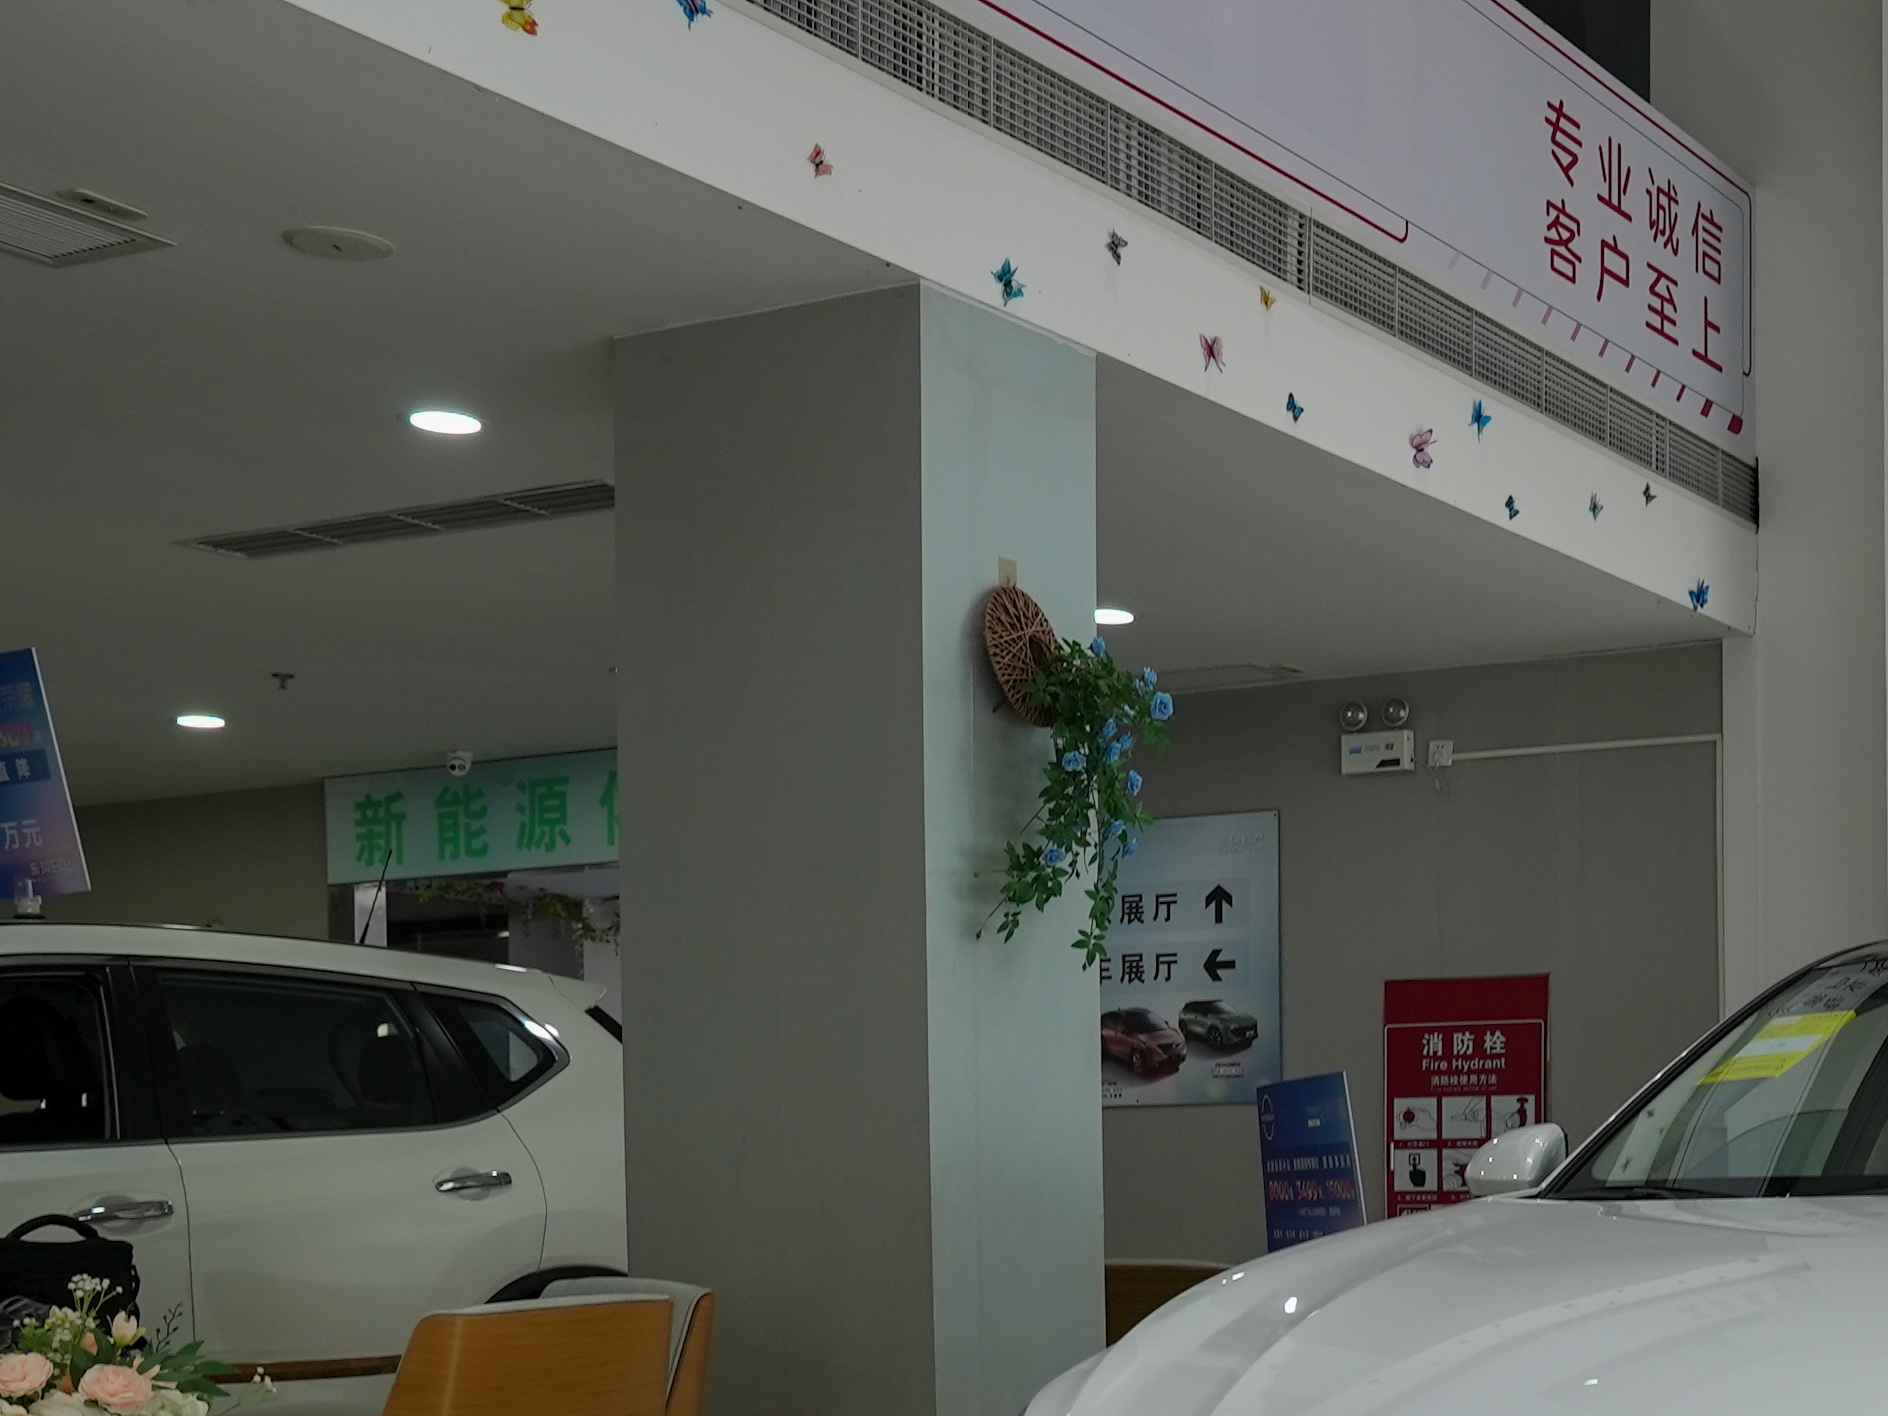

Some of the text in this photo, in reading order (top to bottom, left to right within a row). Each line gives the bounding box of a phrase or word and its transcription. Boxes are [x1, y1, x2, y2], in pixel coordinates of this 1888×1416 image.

[1545, 99, 1723, 285] 专业诚信
[1544, 198, 1723, 372] 客户至上
[1106, 892, 1178, 925] 展厅
[1421, 1030, 1507, 1057] 消防栓
[1421, 1057, 1506, 1073] Fire Hydrant
[1431, 1074, 1498, 1087] 消防栓使用方法
